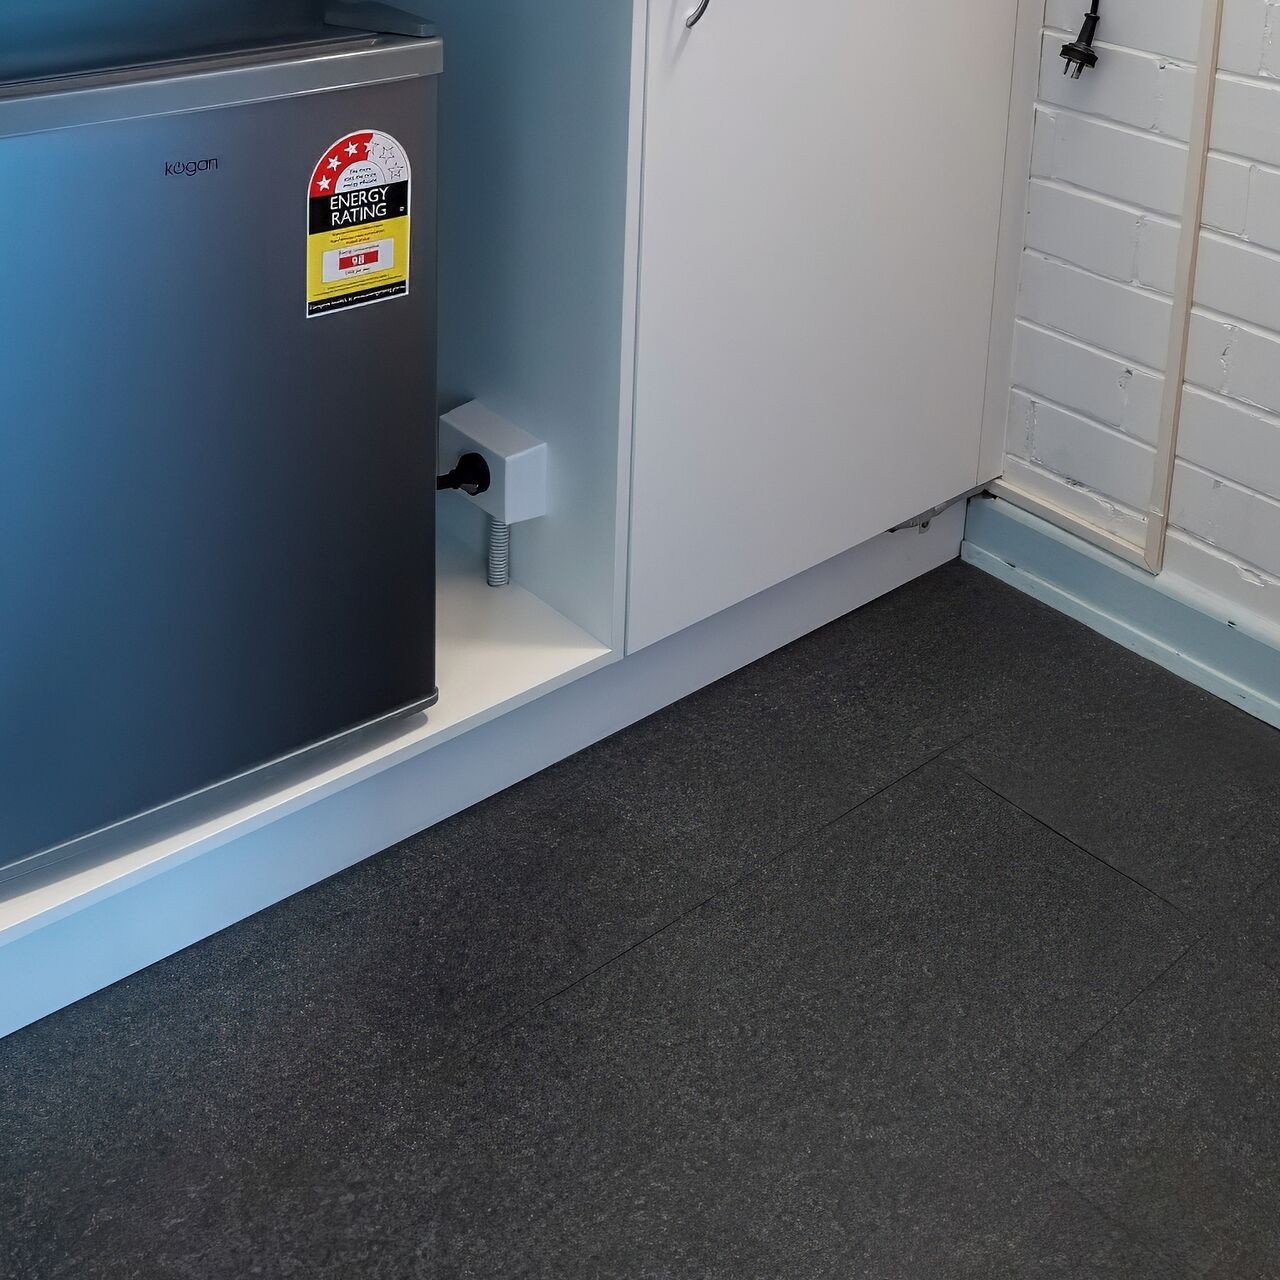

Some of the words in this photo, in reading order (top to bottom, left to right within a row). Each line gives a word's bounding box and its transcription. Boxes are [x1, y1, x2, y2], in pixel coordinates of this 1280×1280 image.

[164, 158, 219, 177] kogan
[330, 186, 389, 210] ENERGY
[331, 202, 387, 226] RATING
